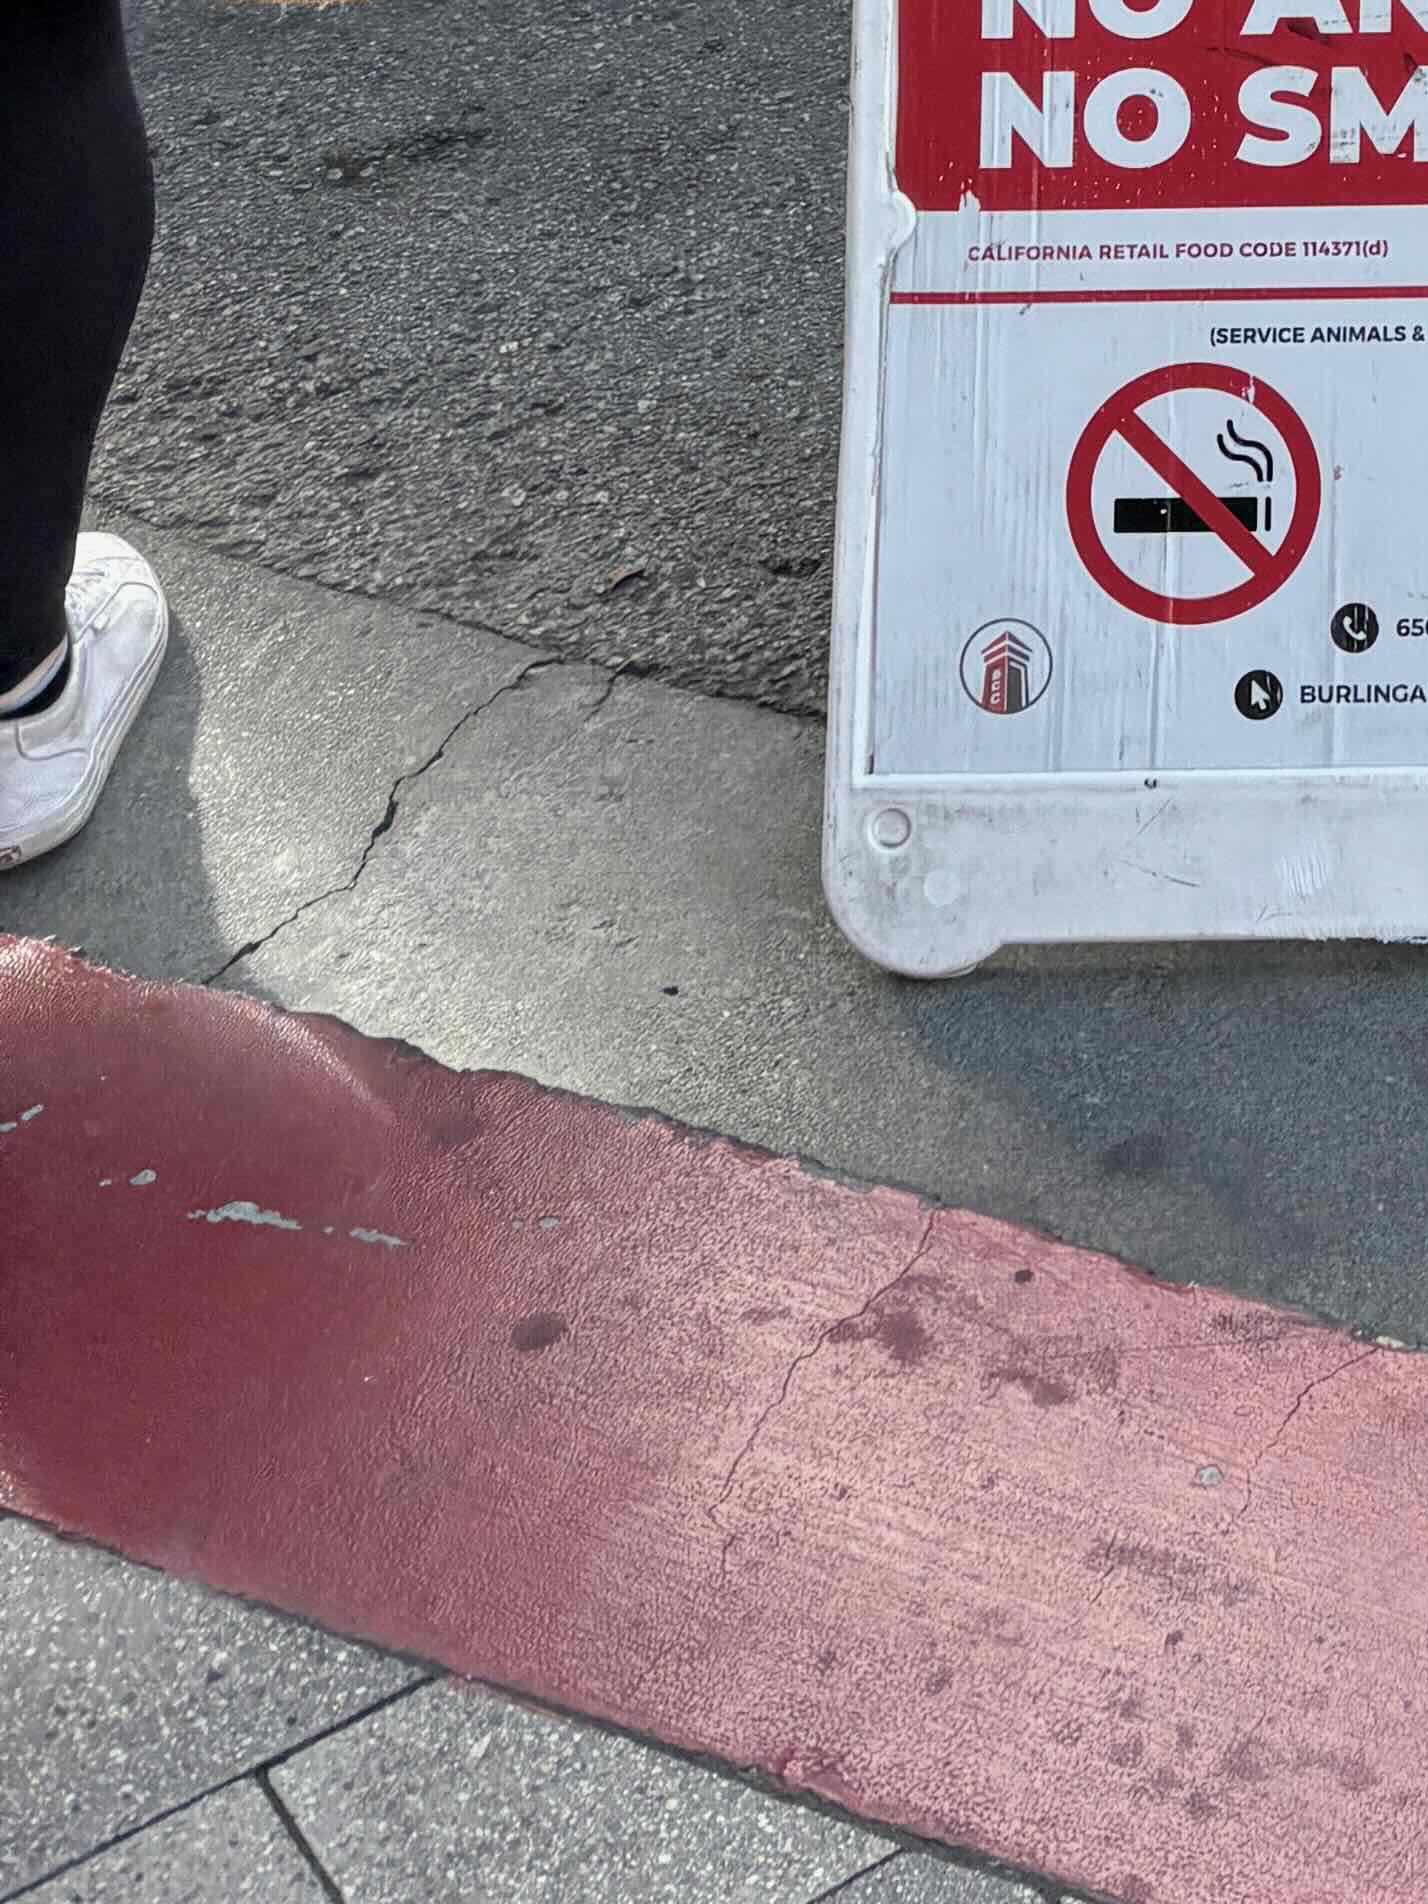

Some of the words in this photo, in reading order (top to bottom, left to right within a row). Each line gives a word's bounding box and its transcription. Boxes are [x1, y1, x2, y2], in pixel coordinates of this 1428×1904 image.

[979, 67, 1192, 169] NO
[967, 243, 1093, 261] CALIFORNIA
[1099, 242, 1169, 260] RETAIL
[1175, 242, 1233, 258] FOOD
[1239, 241, 1297, 257] CODE
[1302, 239, 1389, 258] 114371(d)
[1209, 326, 1305, 346] (SERVICE
[1310, 324, 1407, 343] ANIMALS
[1411, 324, 1425, 342] &
